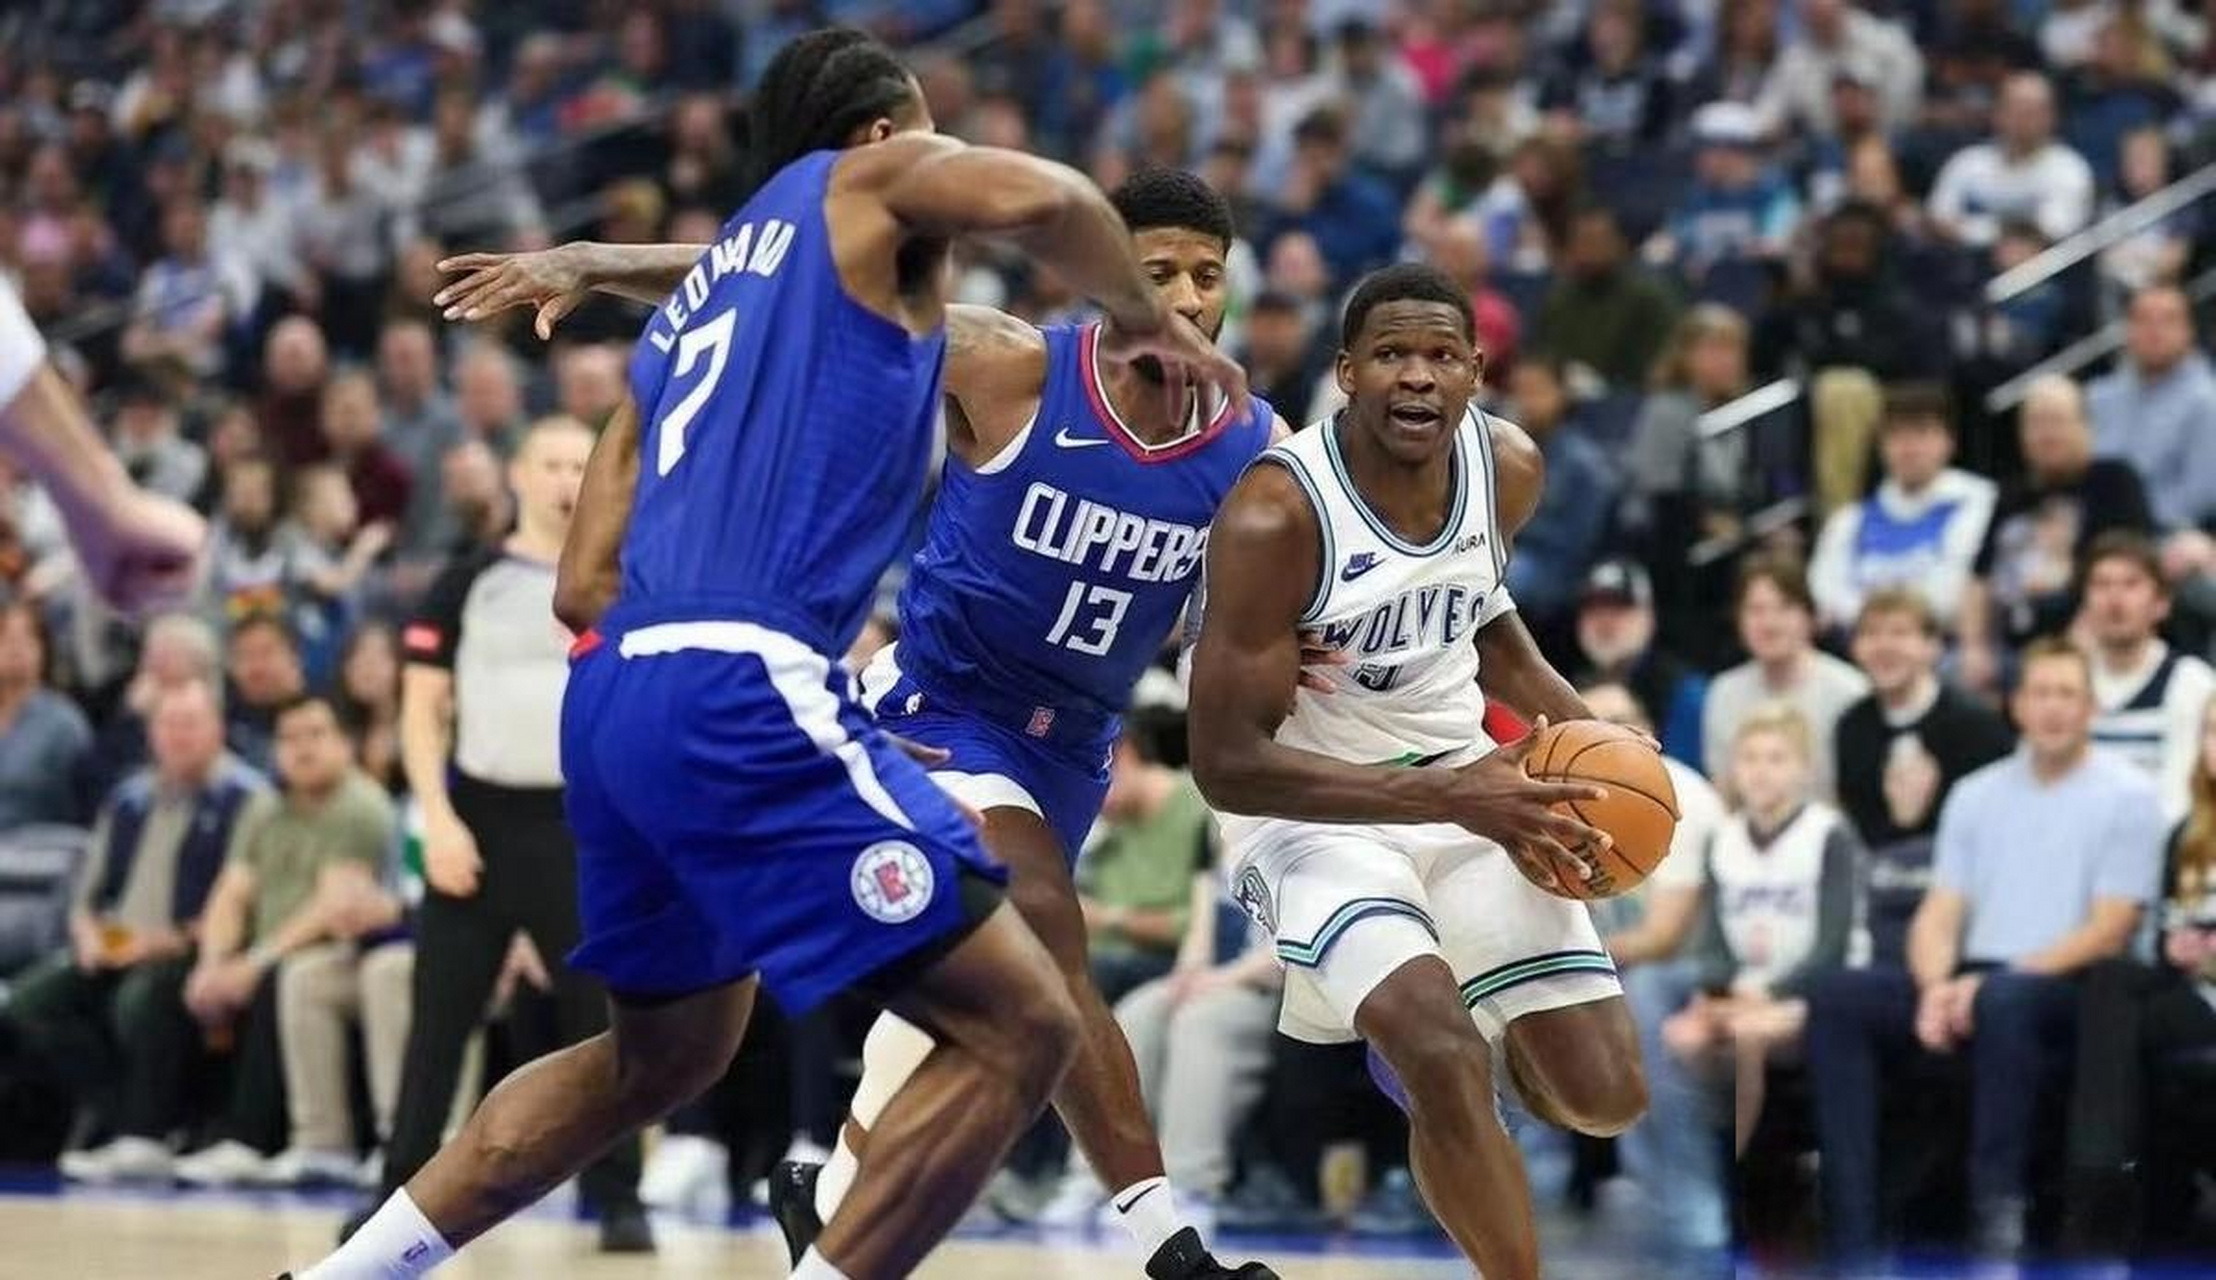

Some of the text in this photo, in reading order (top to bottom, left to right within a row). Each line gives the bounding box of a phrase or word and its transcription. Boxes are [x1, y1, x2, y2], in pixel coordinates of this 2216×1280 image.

[650, 219, 796, 355] LEON
[657, 306, 737, 478] 7
[1011, 480, 1209, 583] CLIPPERS
[1045, 579, 1134, 656] 13
